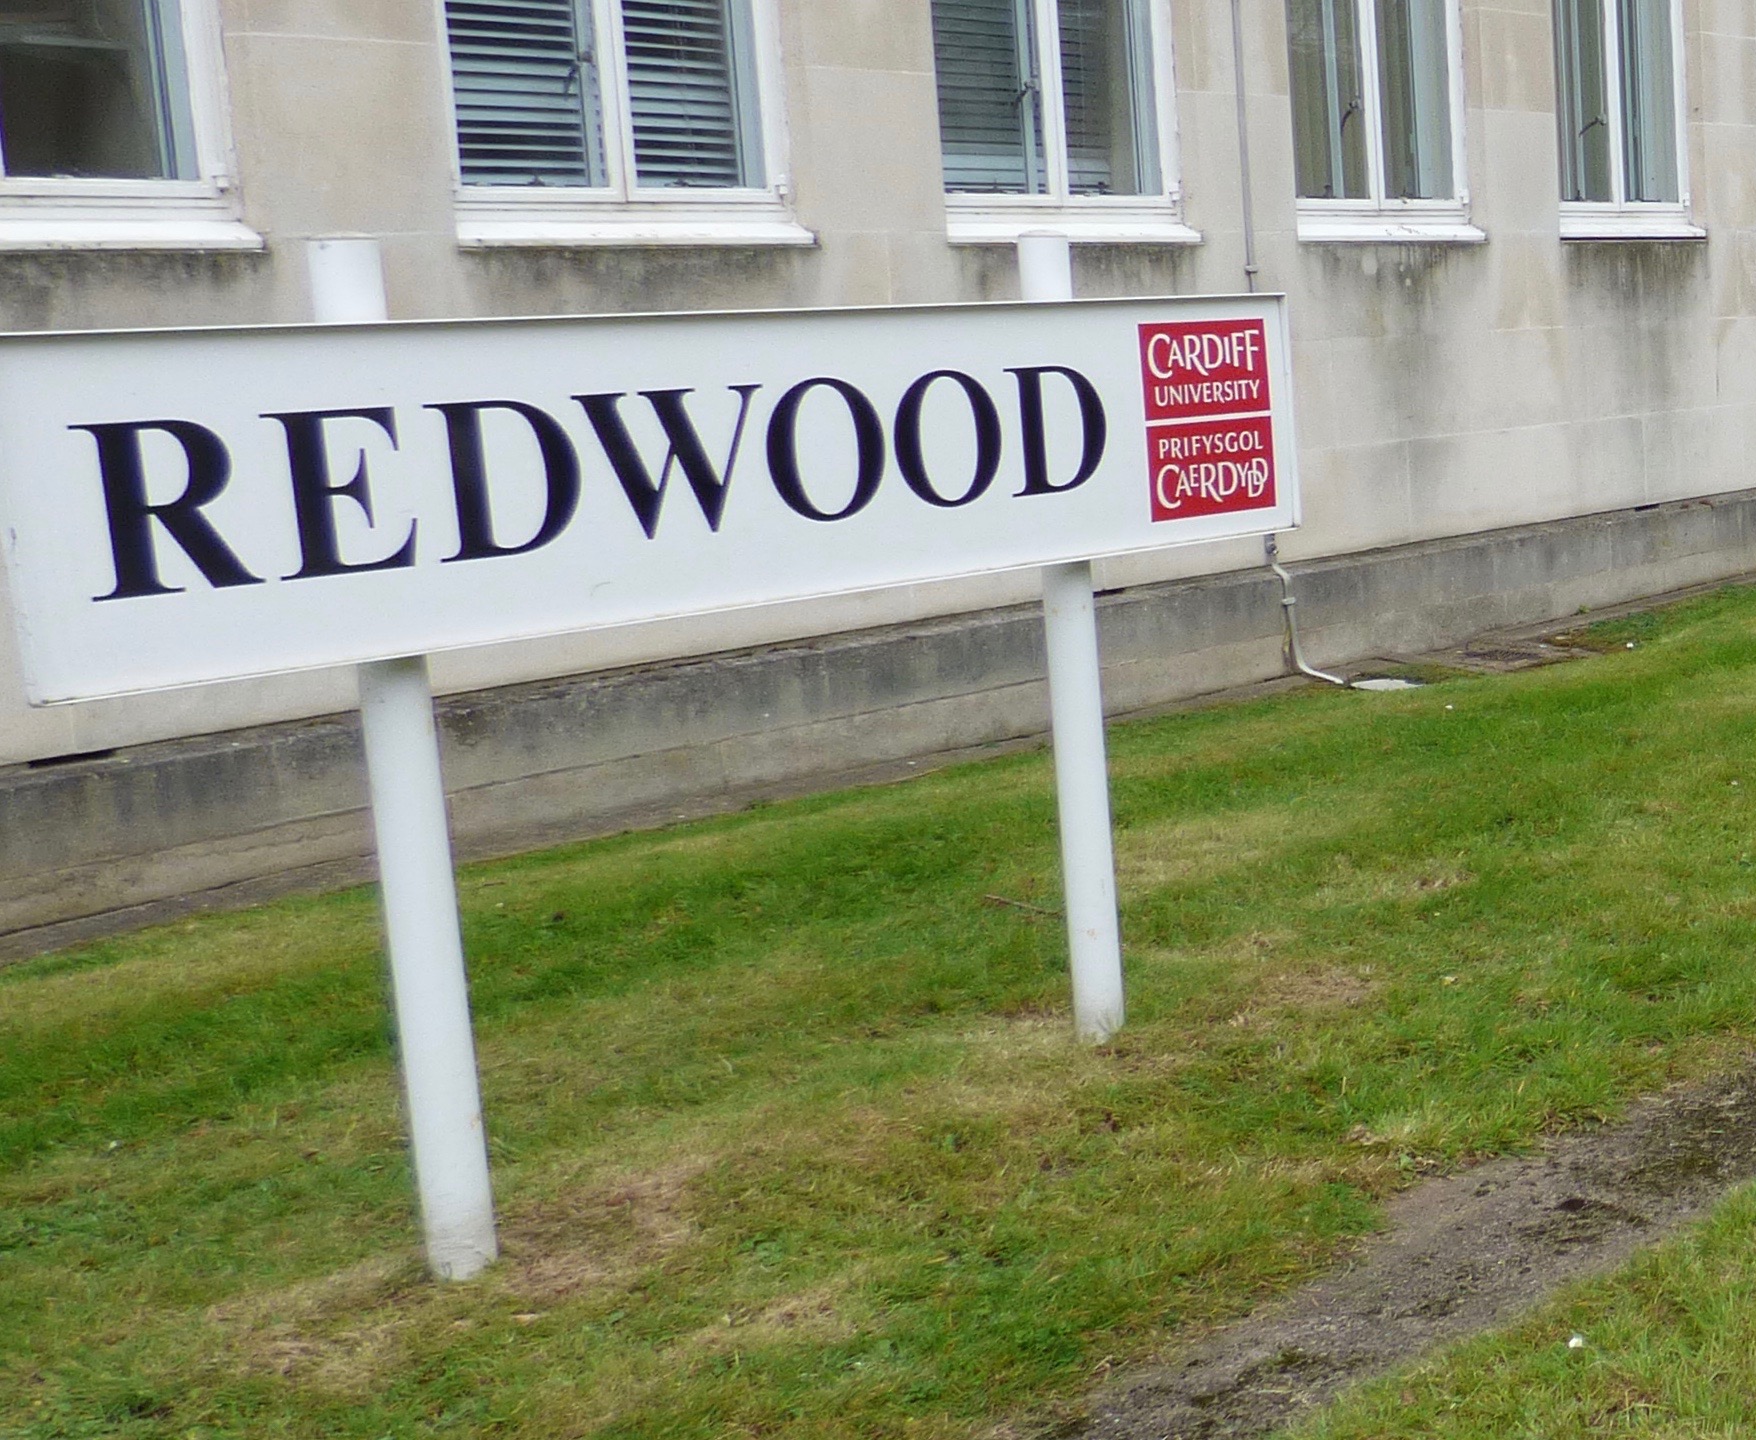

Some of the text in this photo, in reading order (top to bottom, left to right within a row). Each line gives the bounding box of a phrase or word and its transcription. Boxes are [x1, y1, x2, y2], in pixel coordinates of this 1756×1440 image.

[1148, 329, 1260, 379] CARDIFF
[1154, 379, 1260, 407] UNIVERSITY
[1159, 431, 1264, 459] PRIFYSGOL
[66, 365, 1106, 602] REDWOOD
